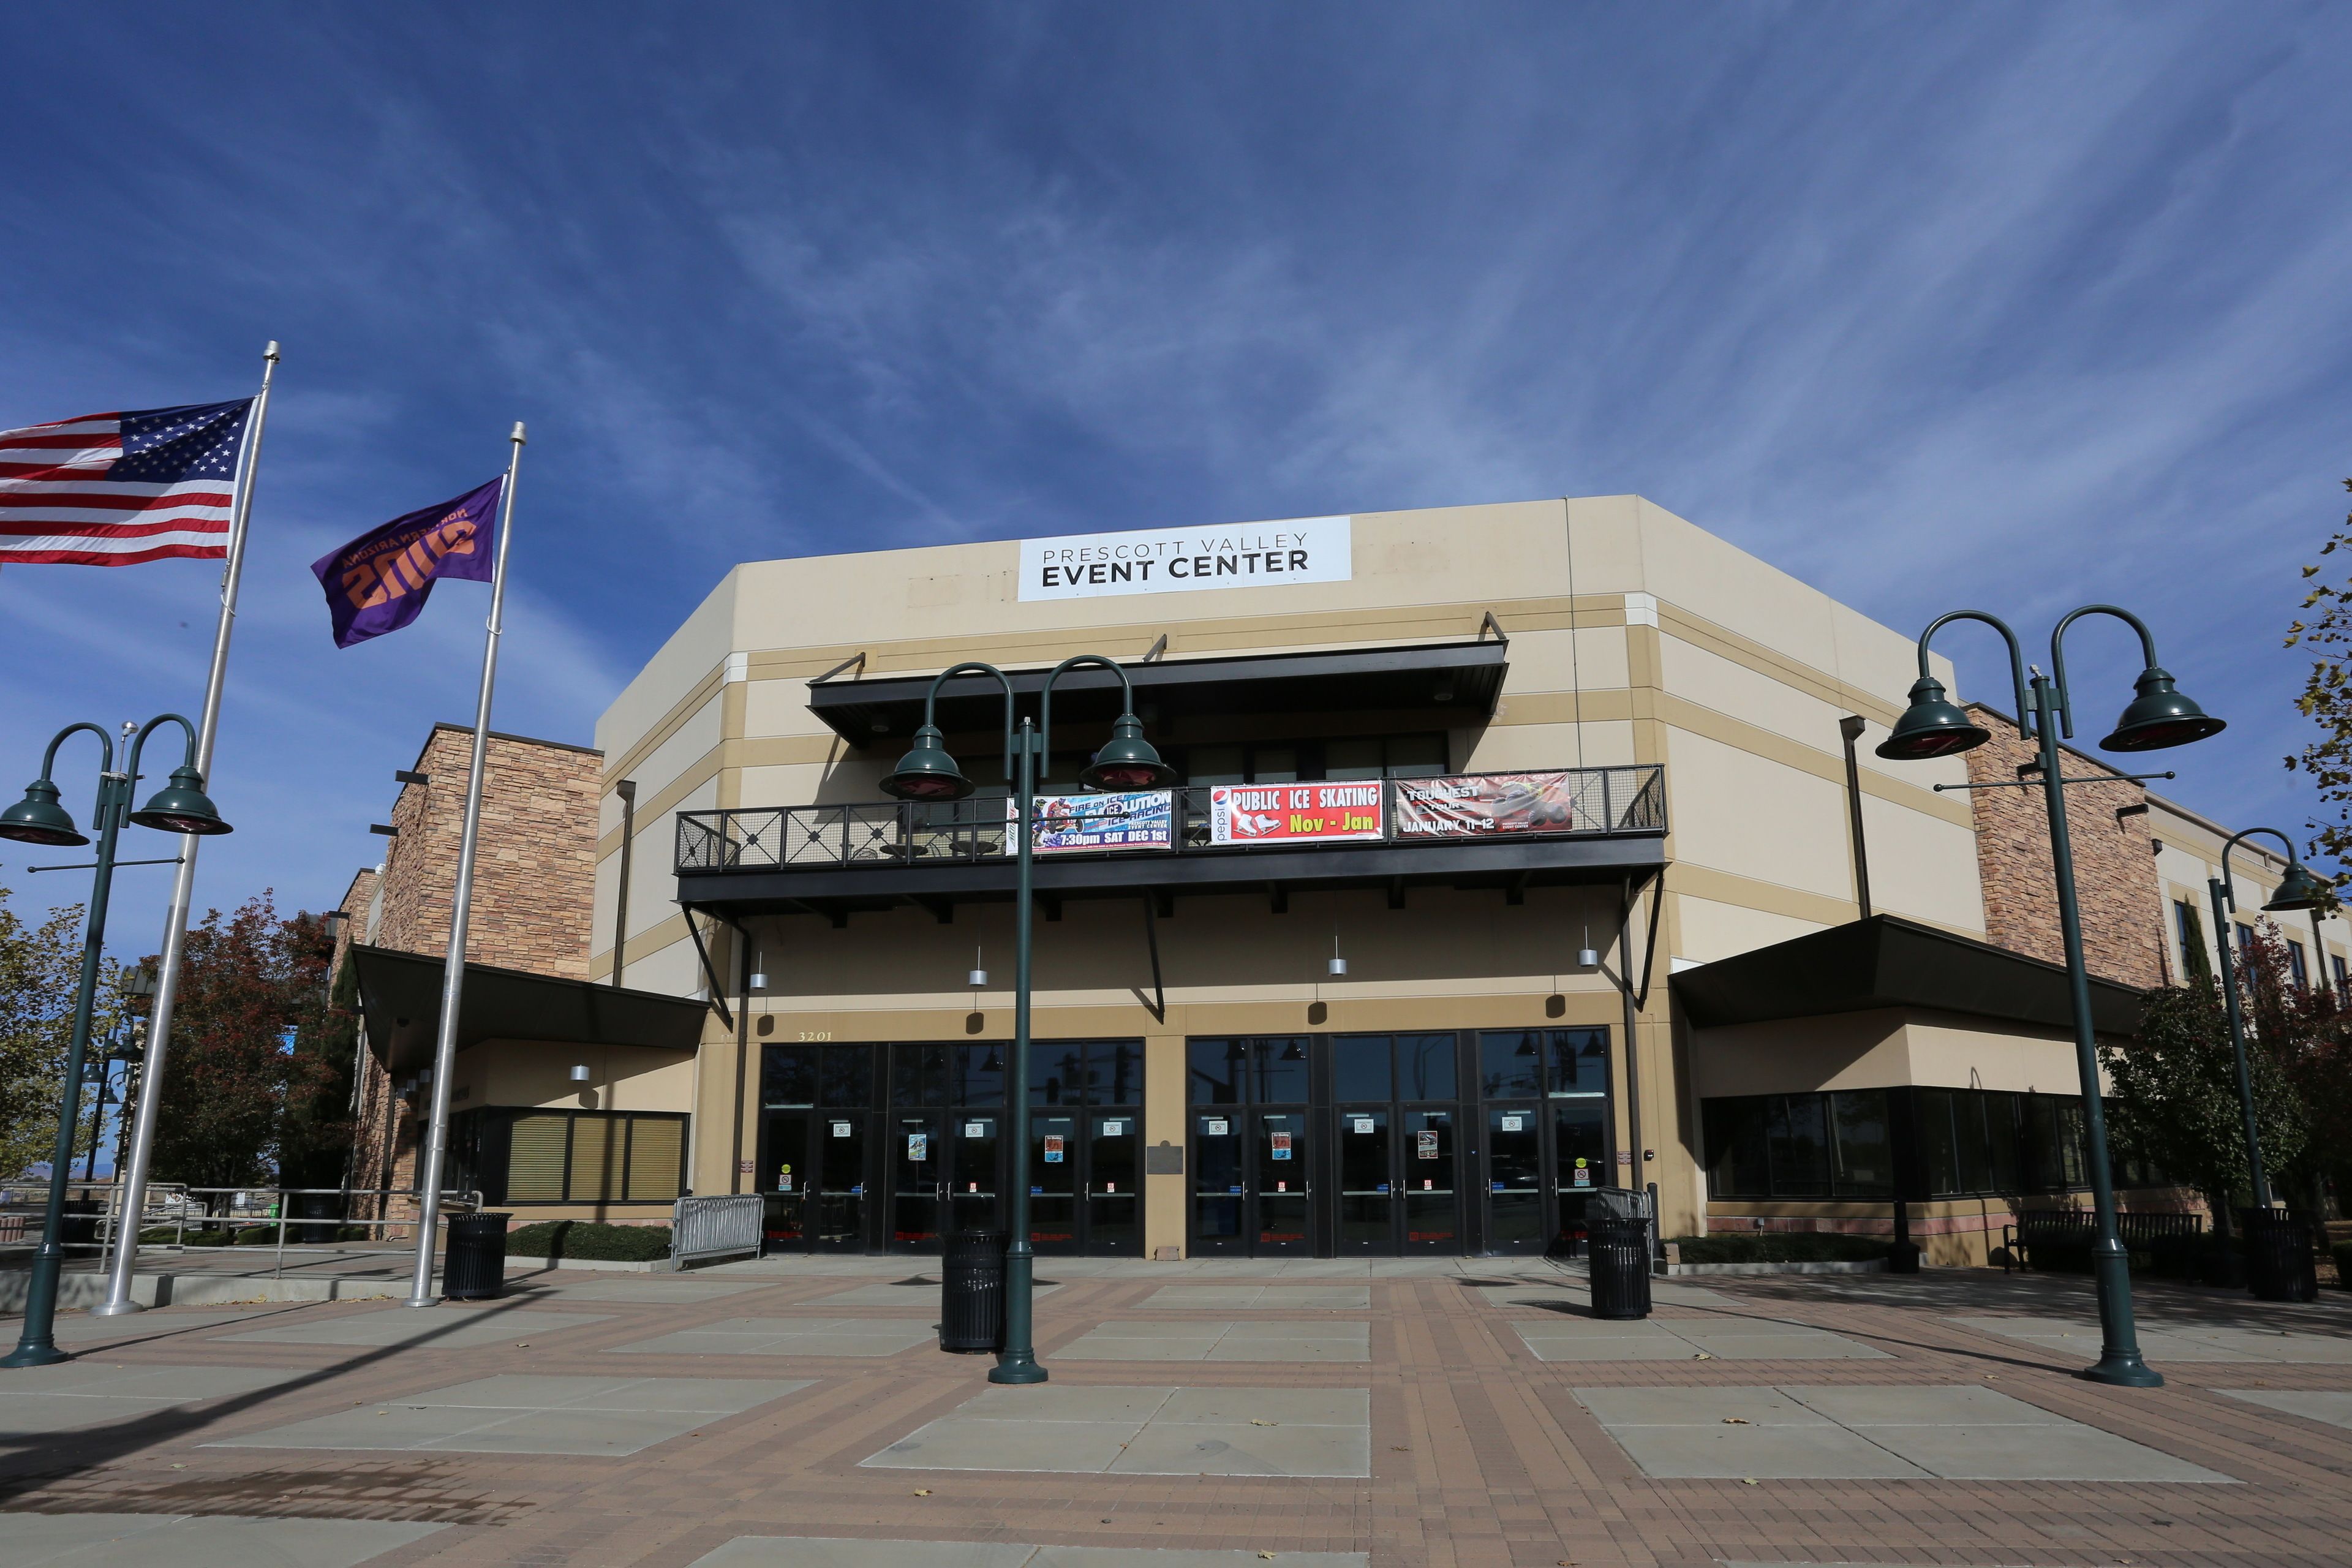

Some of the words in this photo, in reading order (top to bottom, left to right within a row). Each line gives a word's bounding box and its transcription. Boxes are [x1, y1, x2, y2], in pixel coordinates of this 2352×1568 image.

[1043, 541, 1185, 564] PRESCOTT
[1201, 532, 1308, 552] VALLEY
[1042, 560, 1155, 587] EVENT
[1169, 549, 1308, 579] CENTER
[1234, 790, 1280, 812] PUBLIC
[1289, 789, 1310, 809] ICE
[1319, 787, 1378, 808] SKATING
[1407, 786, 1480, 801] TOUGHEST
[1069, 802, 1092, 813] FIRE
[1106, 805, 1119, 815] ICE
[1108, 817, 1126, 826] ICE
[1130, 804, 1172, 821] RACING
[1215, 807, 1227, 841] pepsi
[1290, 814, 1324, 833] Nov
[1343, 812, 1373, 831] Jan
[1403, 820, 1461, 833] JANUARY
[1060, 834, 1101, 846] 7:30pm
[1104, 832, 1125, 843] SAT
[1128, 830, 1148, 842] DEC
[1152, 829, 1167, 841] 1st
[798, 1031, 832, 1041] 3201
